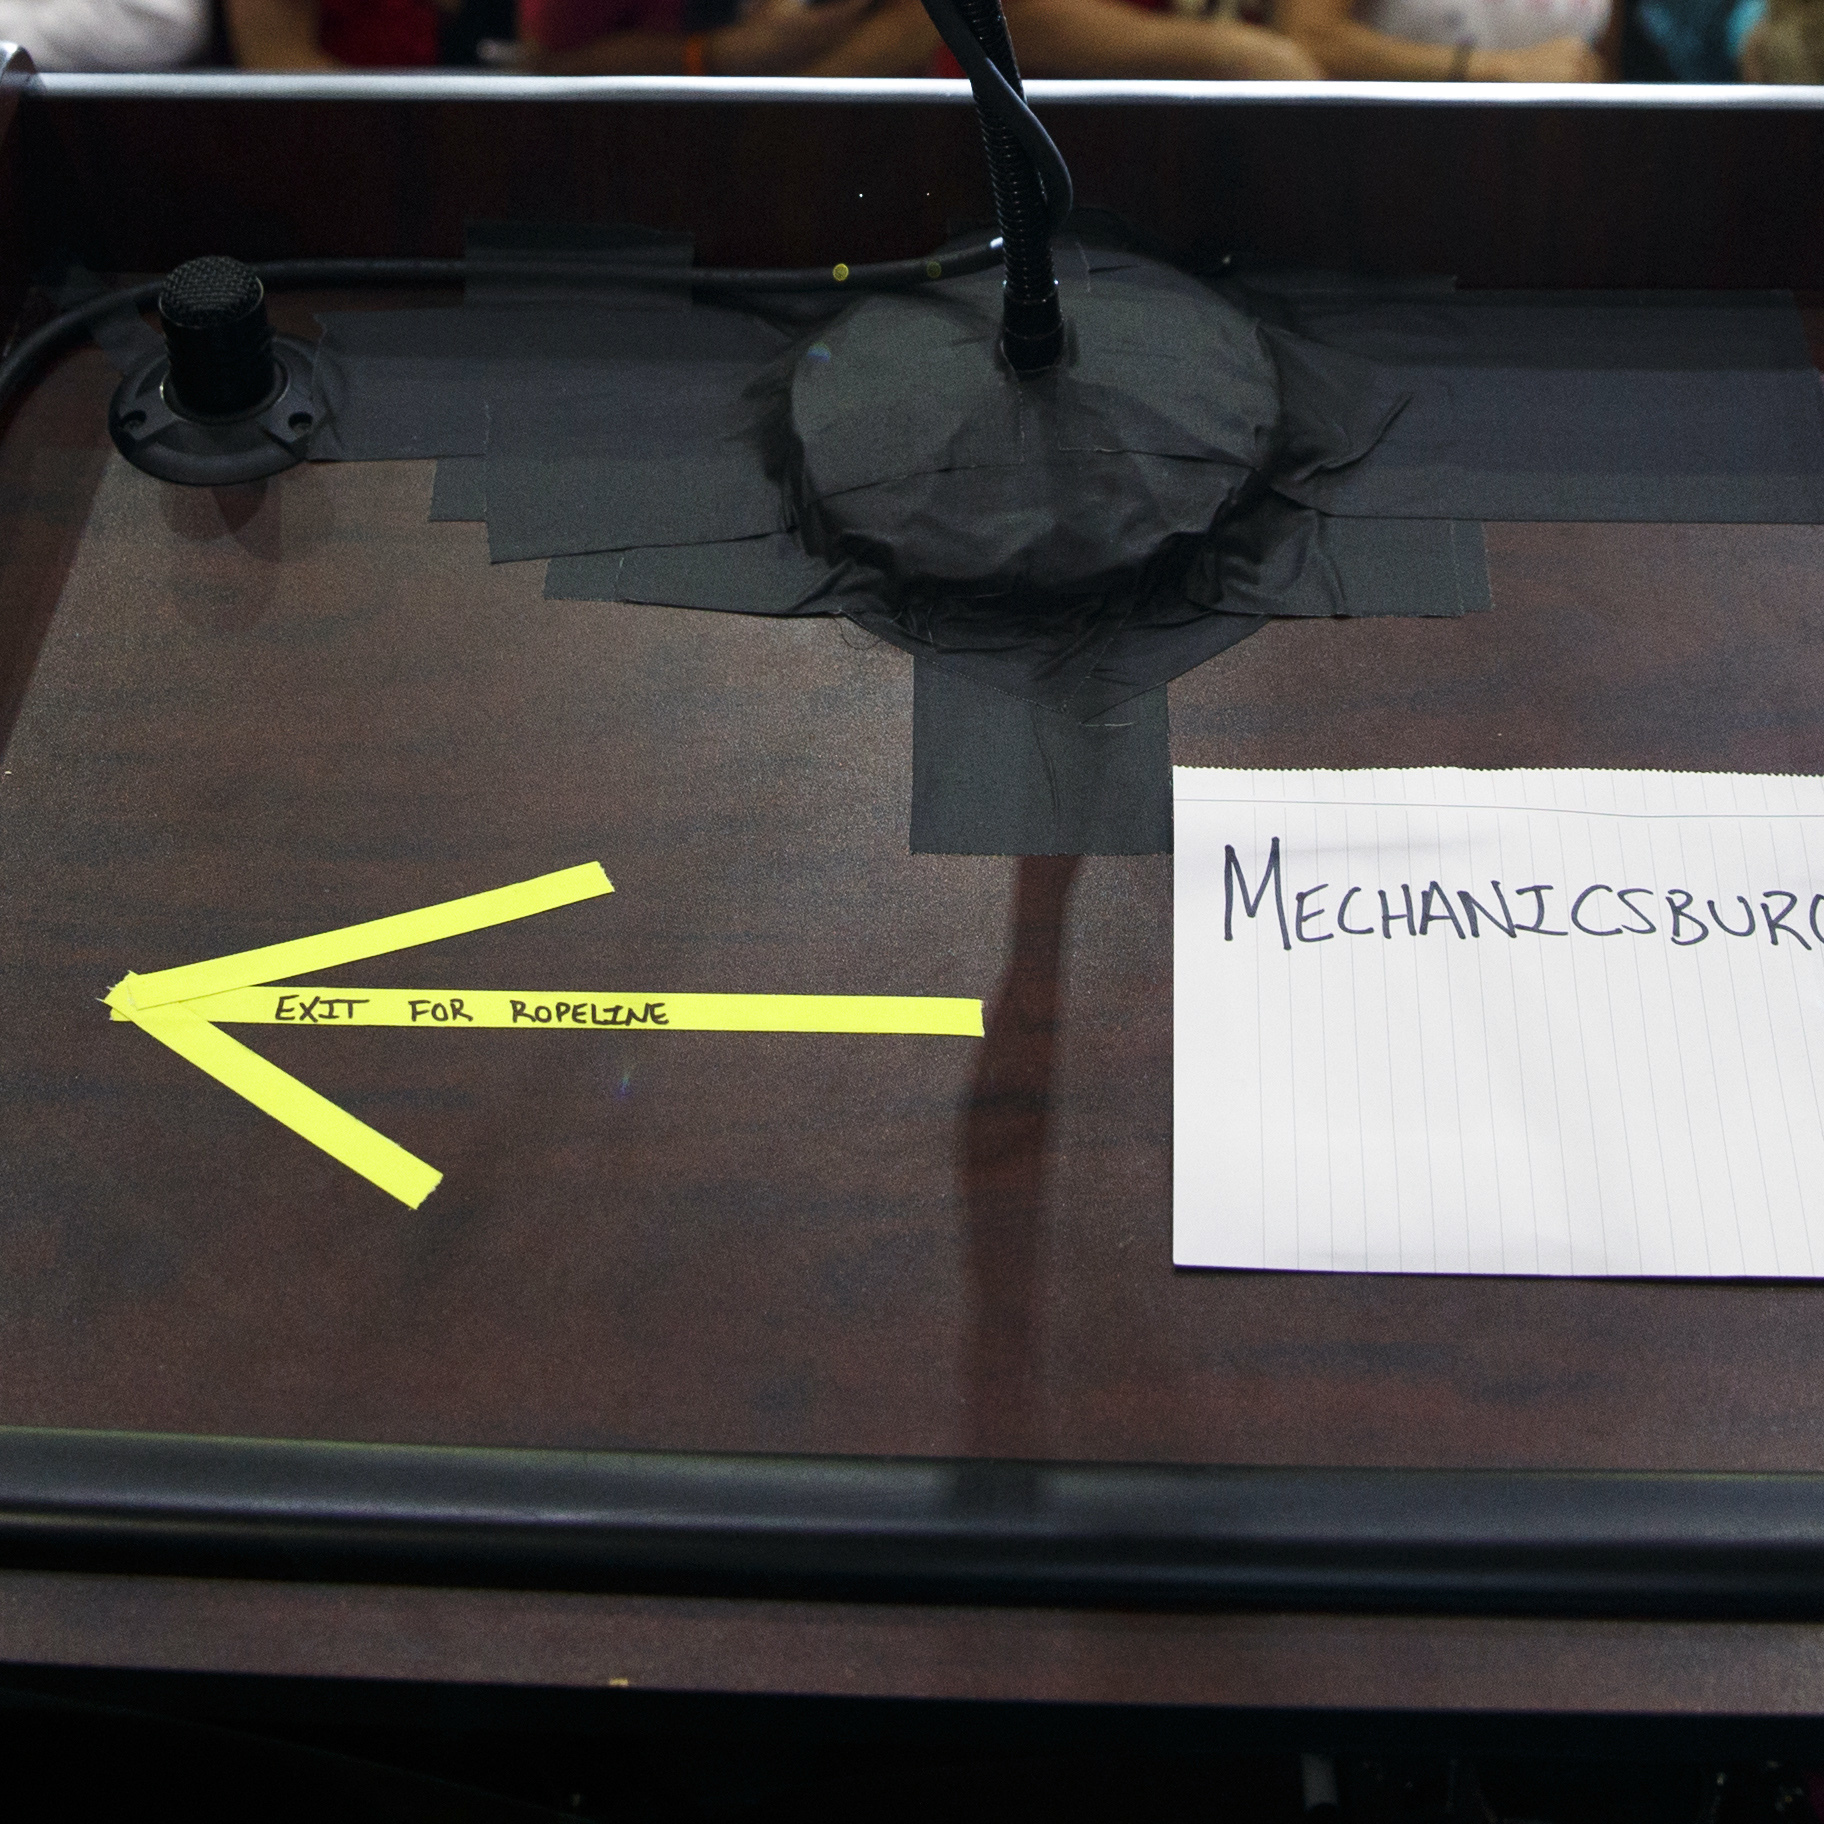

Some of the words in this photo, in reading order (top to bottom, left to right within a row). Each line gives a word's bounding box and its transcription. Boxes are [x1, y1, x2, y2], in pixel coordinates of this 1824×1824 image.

[275, 994, 370, 1026] EXIT
[409, 999, 475, 1025] FOR
[510, 1000, 671, 1028] ROPELINE
